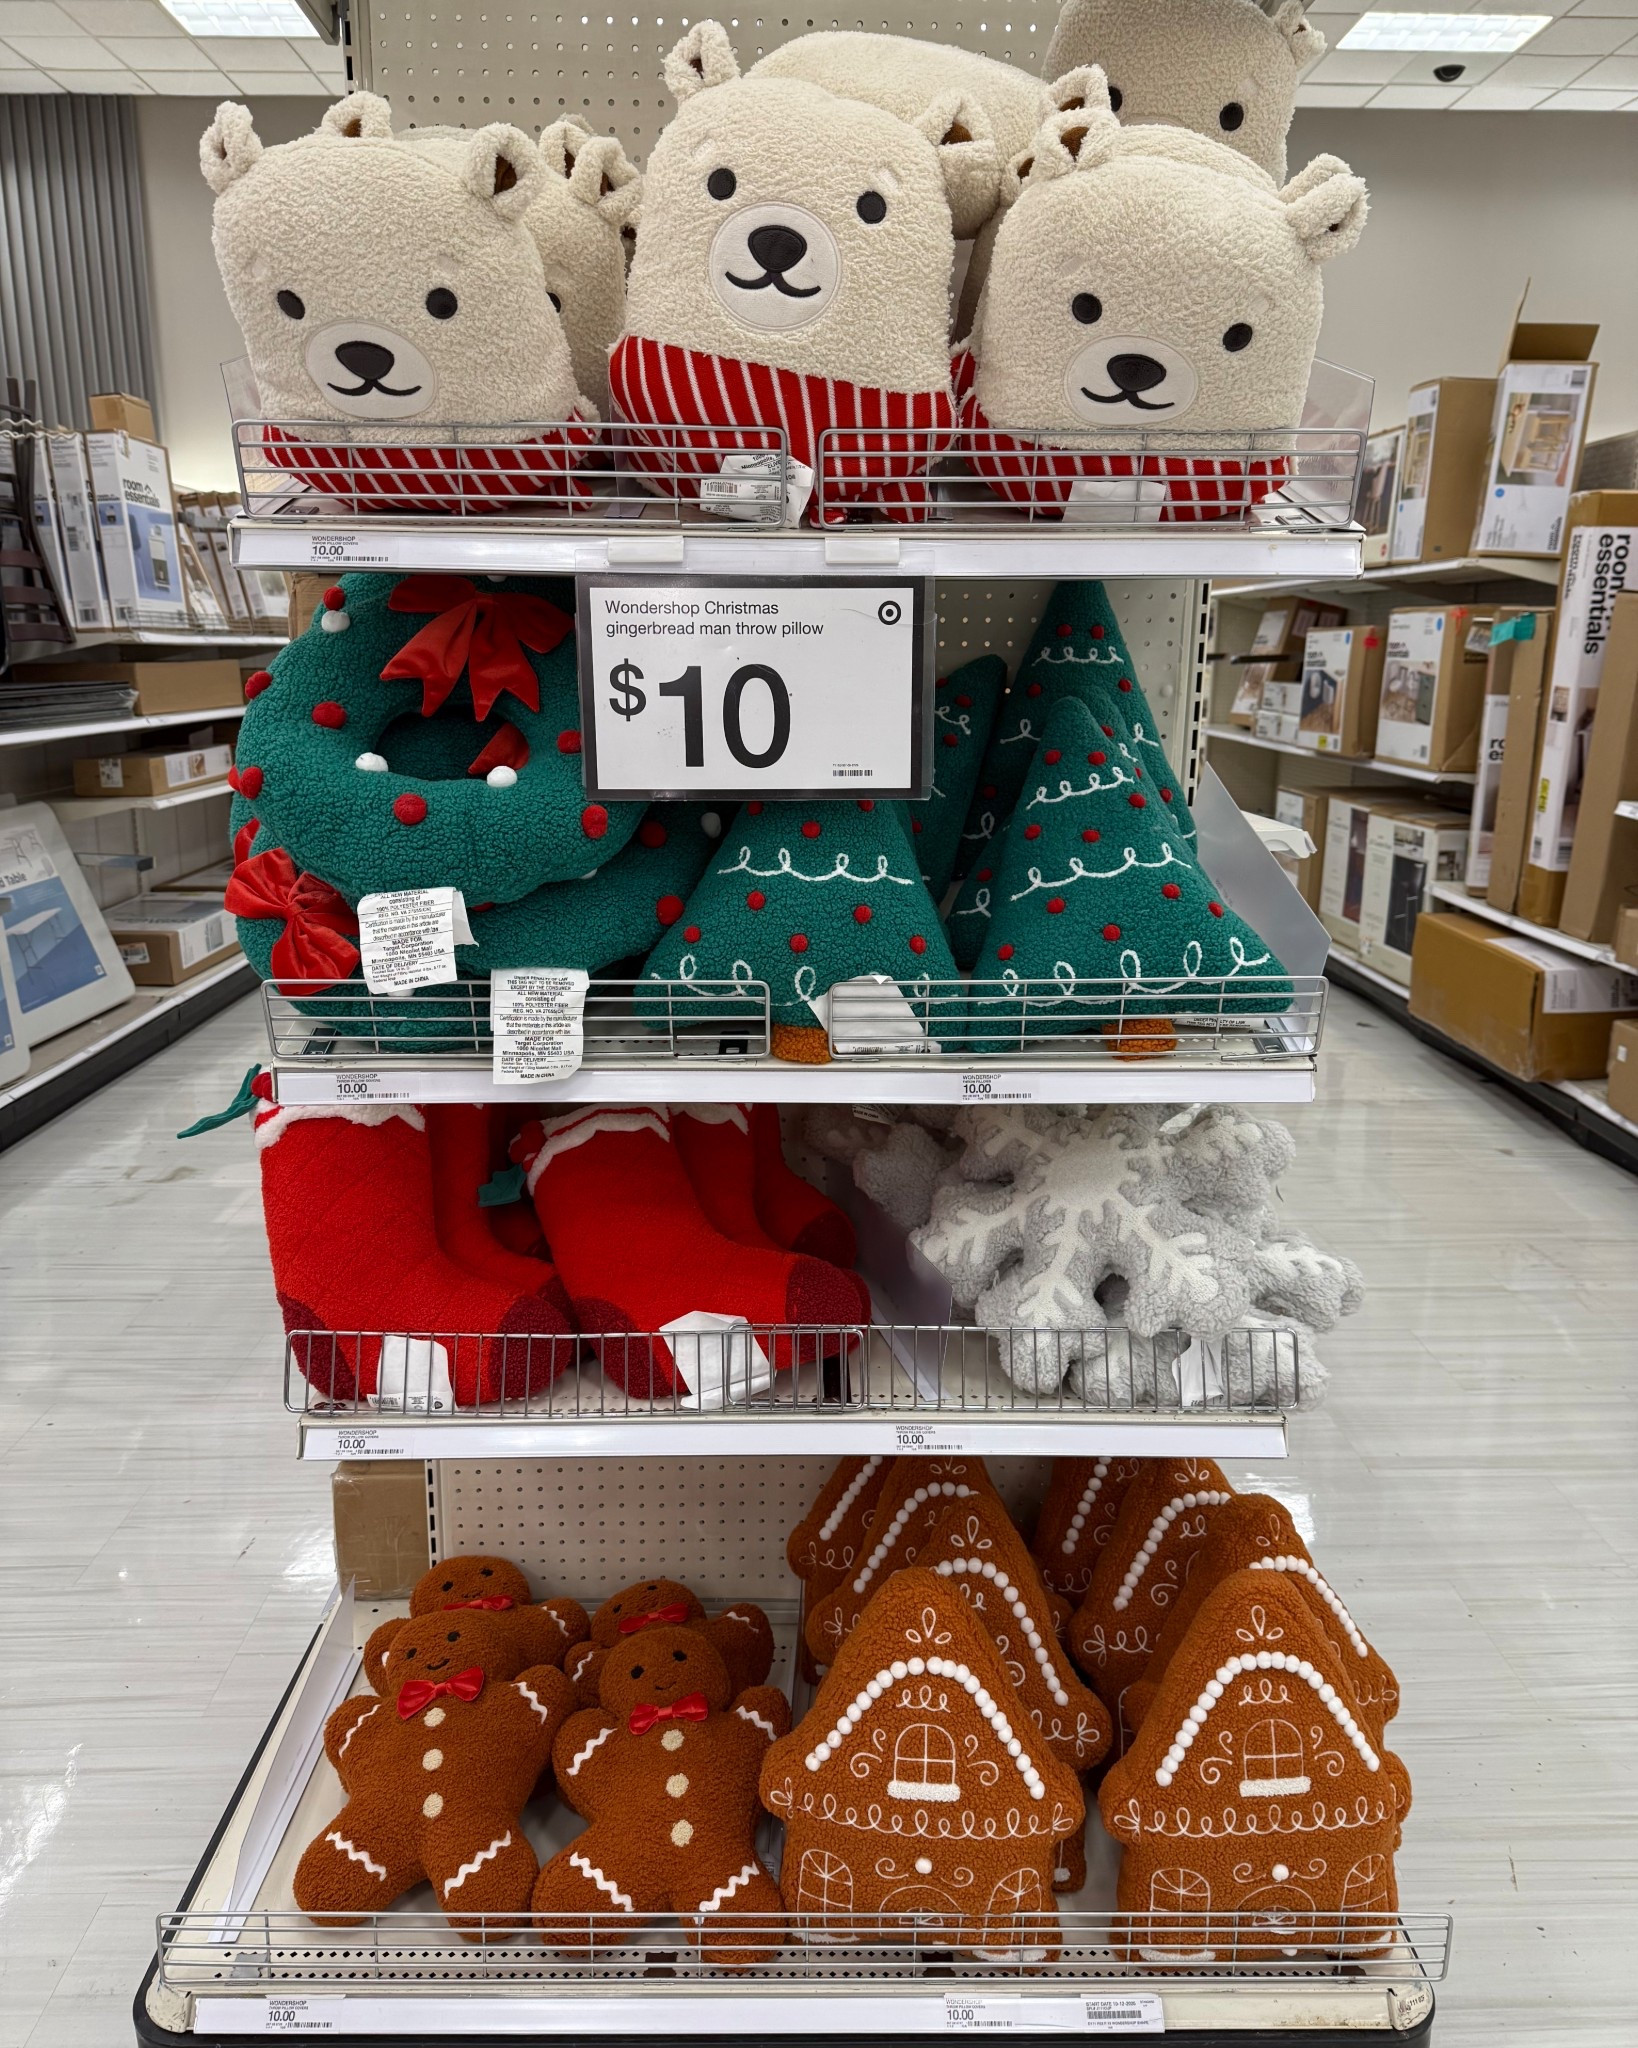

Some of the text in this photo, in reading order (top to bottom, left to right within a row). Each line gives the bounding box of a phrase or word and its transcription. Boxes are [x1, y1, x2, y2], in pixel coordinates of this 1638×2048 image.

[123, 479, 143, 490] room
[312, 546, 344, 555] 10.00
[1584, 533, 1614, 654] essentials
[605, 600, 779, 618] Wondershop Christmas
[606, 620, 824, 637] gingerbread man throw pillow
[609, 658, 792, 769] $10
[401, 940, 433, 950] Corporation
[337, 1083, 367, 1093] 10.00
[964, 1084, 991, 1093] 10.00
[338, 1440, 365, 1448] 10.00
[897, 1435, 924, 1444] 10.00
[269, 2011, 295, 2021] 10.00
[947, 2010, 974, 2020] 10.00
